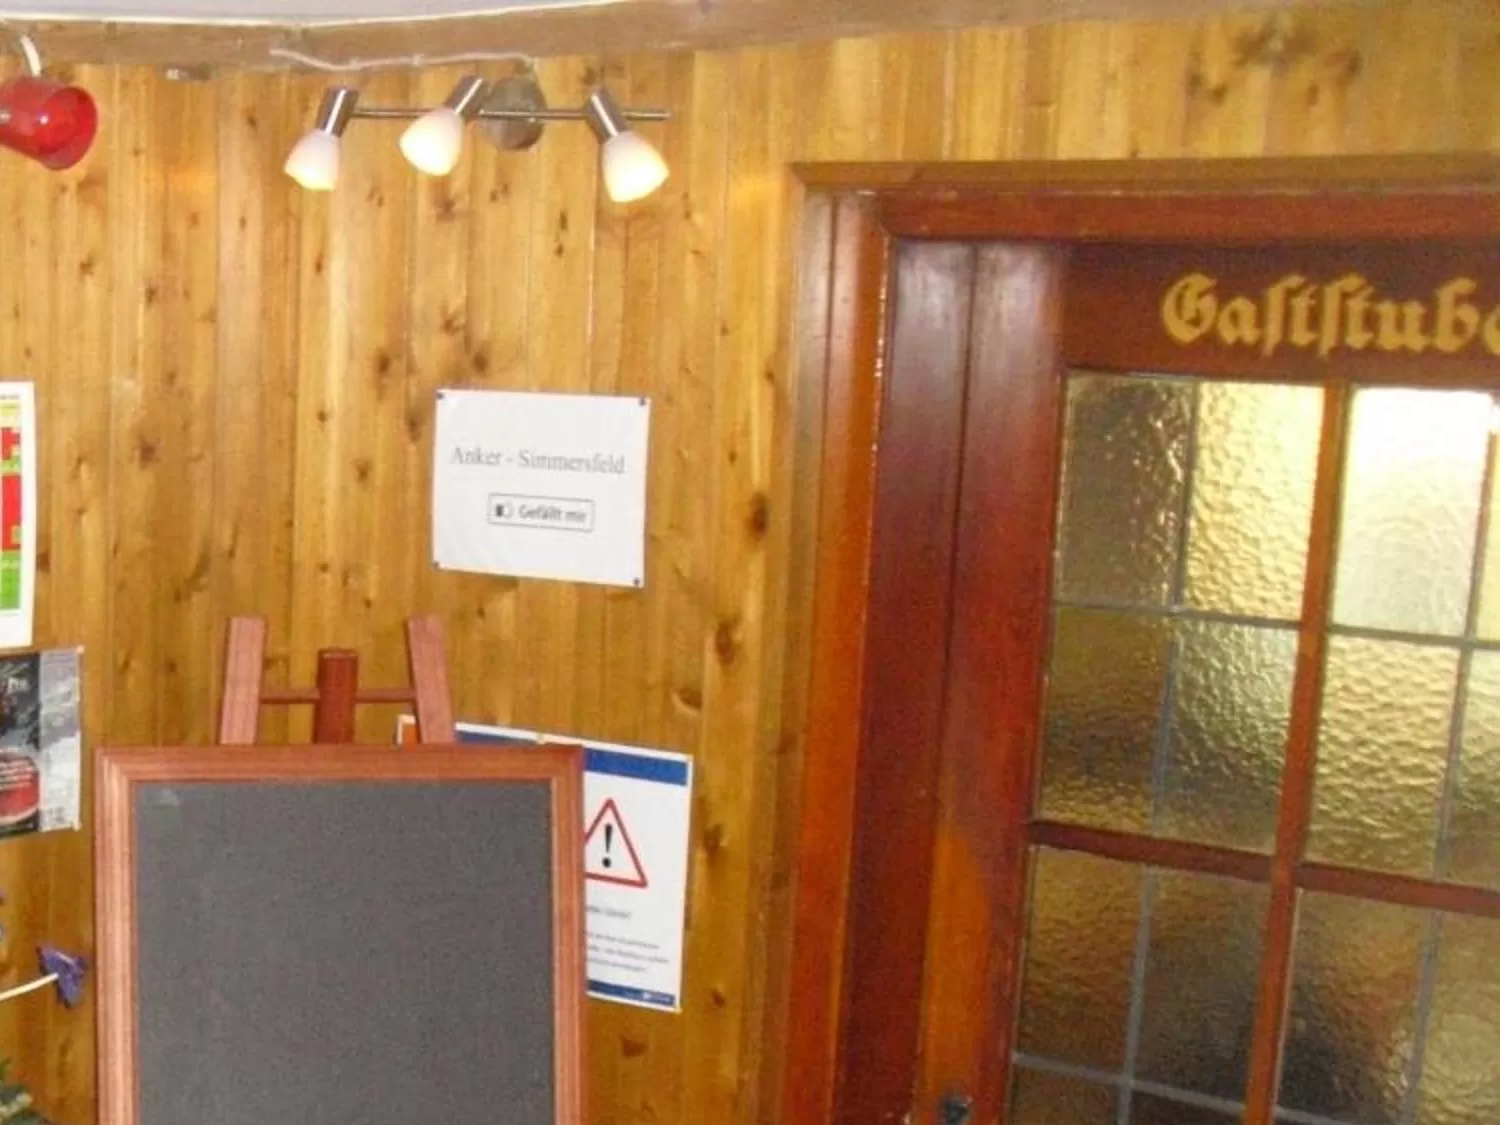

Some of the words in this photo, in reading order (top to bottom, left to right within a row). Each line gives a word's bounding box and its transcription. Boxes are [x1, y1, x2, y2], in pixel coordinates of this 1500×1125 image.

[450, 447, 502, 466] Anker
[517, 450, 626, 475] Simmersfeld
[518, 504, 562, 521] Gefällt
